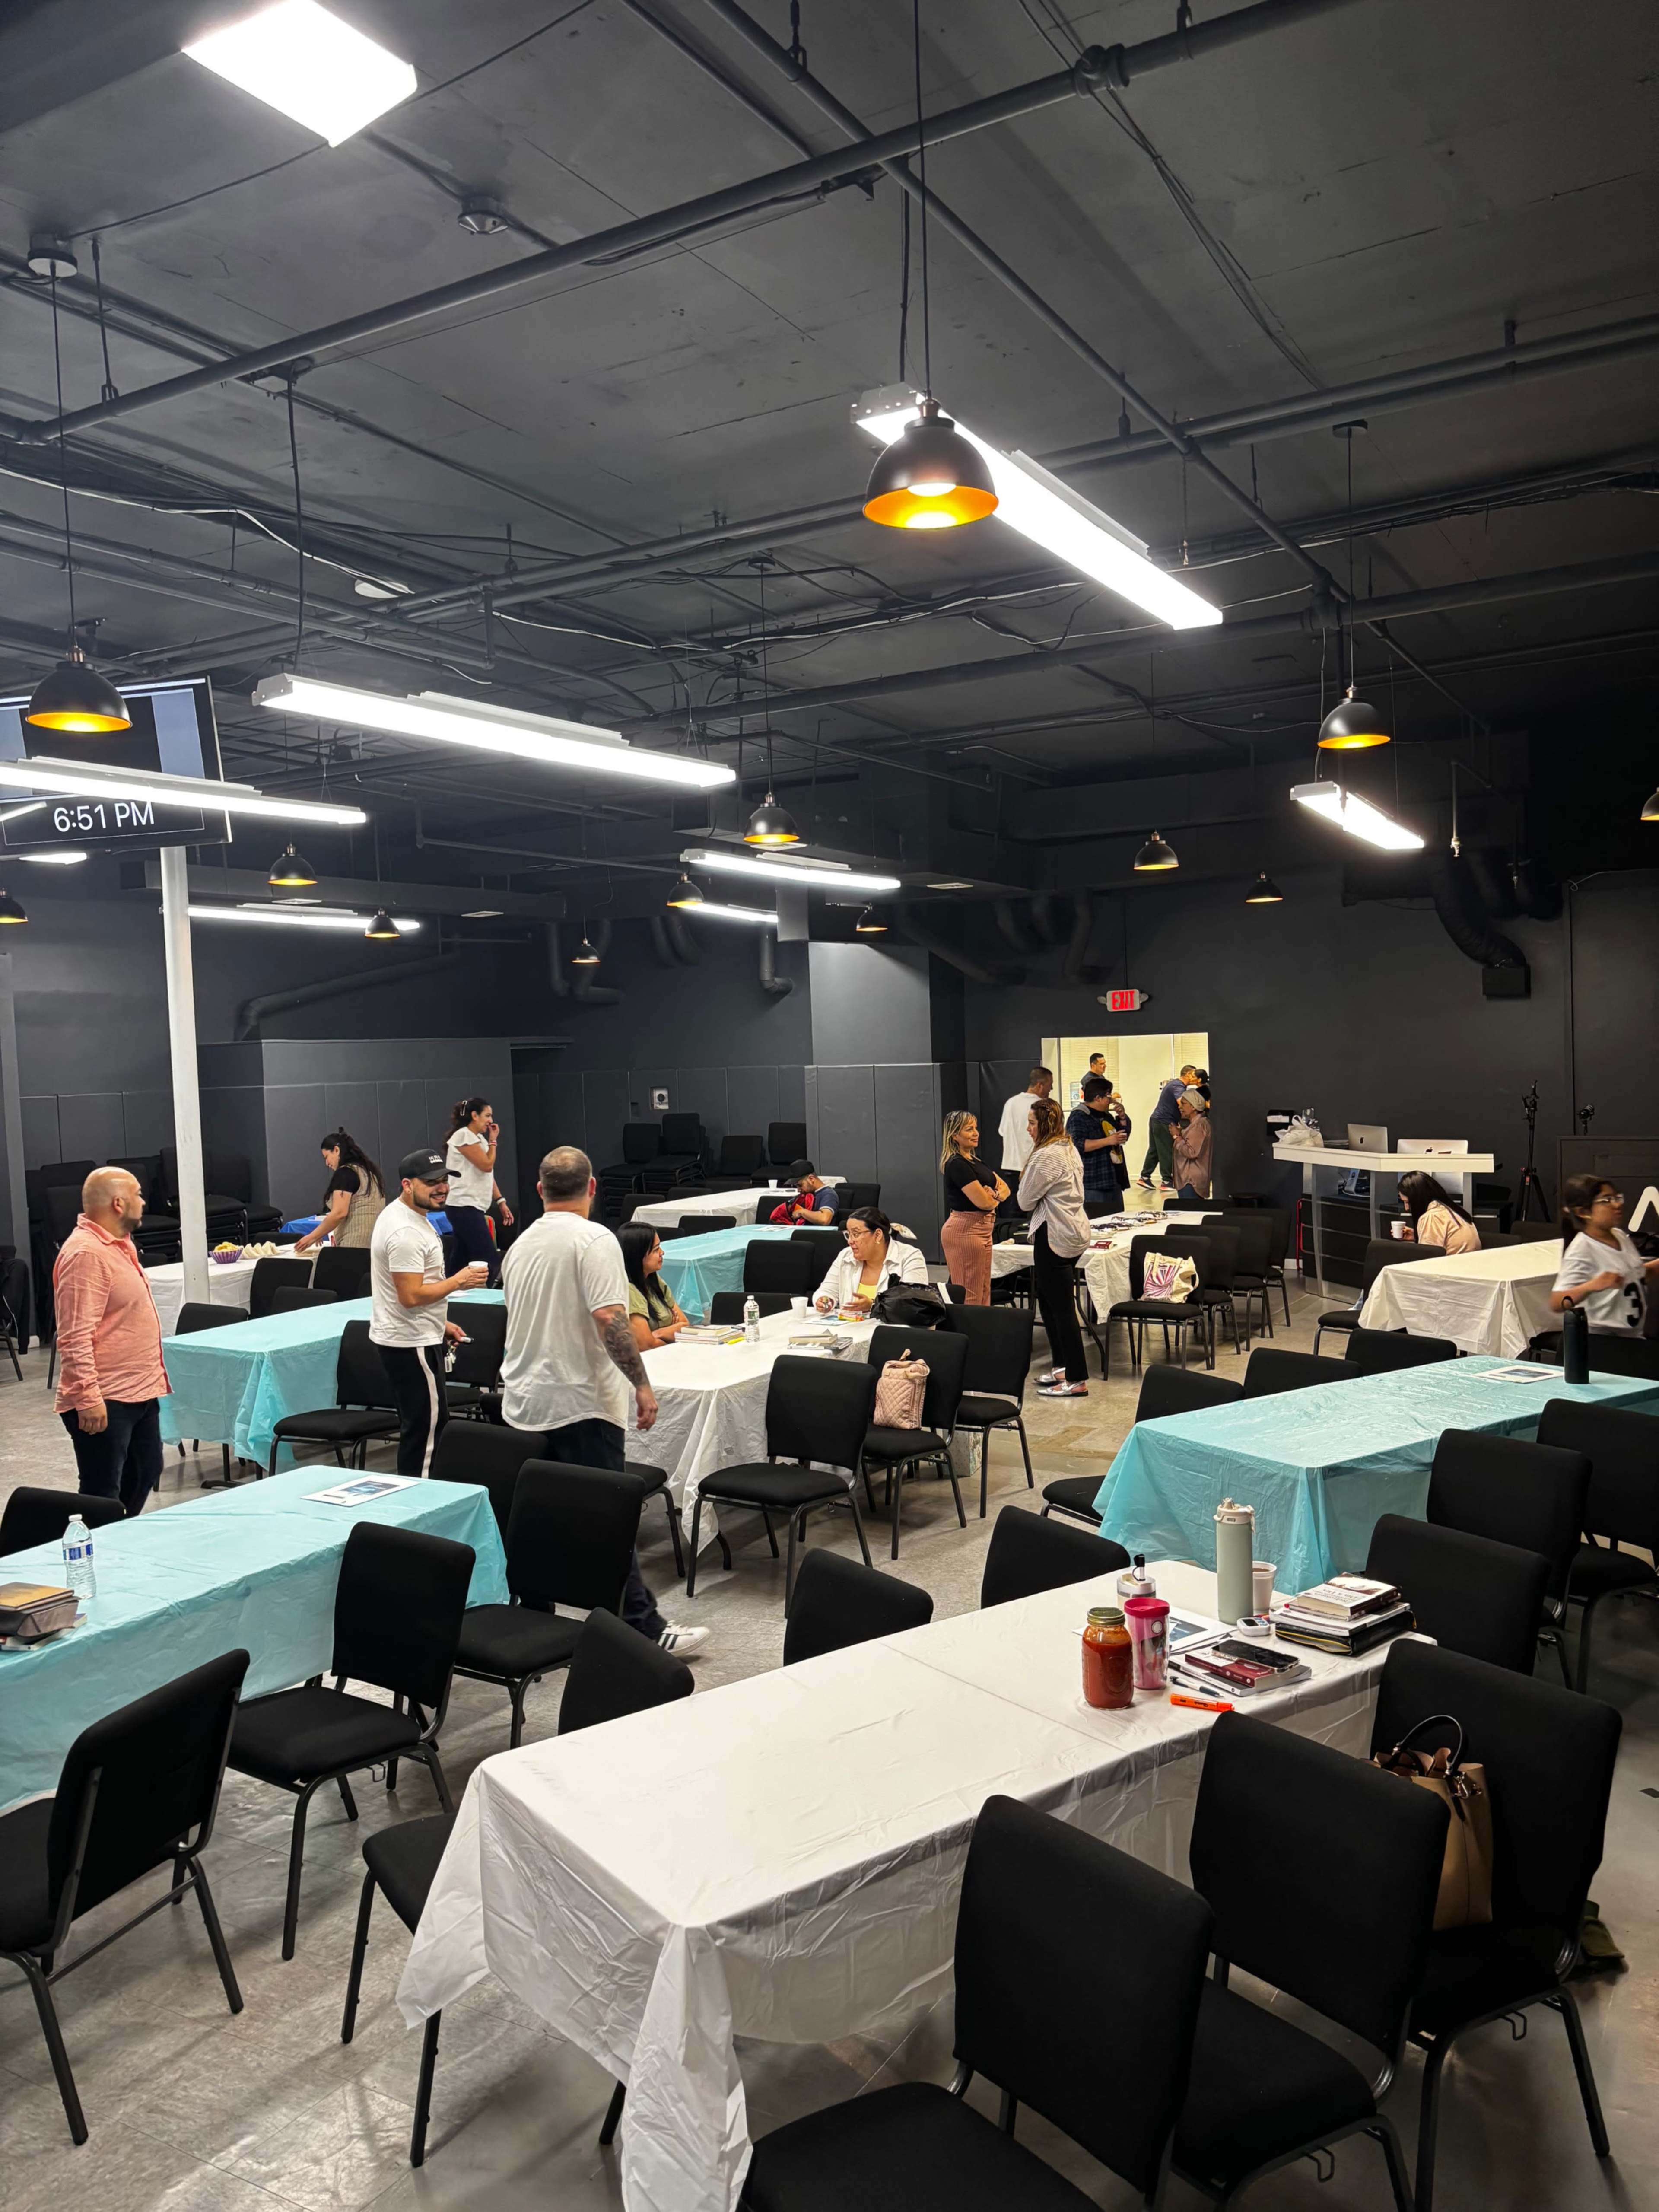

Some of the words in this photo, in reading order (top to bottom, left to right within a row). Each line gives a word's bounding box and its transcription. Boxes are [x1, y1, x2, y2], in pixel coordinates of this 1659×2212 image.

[54, 804, 107, 832] 6:51
[114, 801, 155, 828] PM
[1112, 990, 1135, 1010] EXIT
